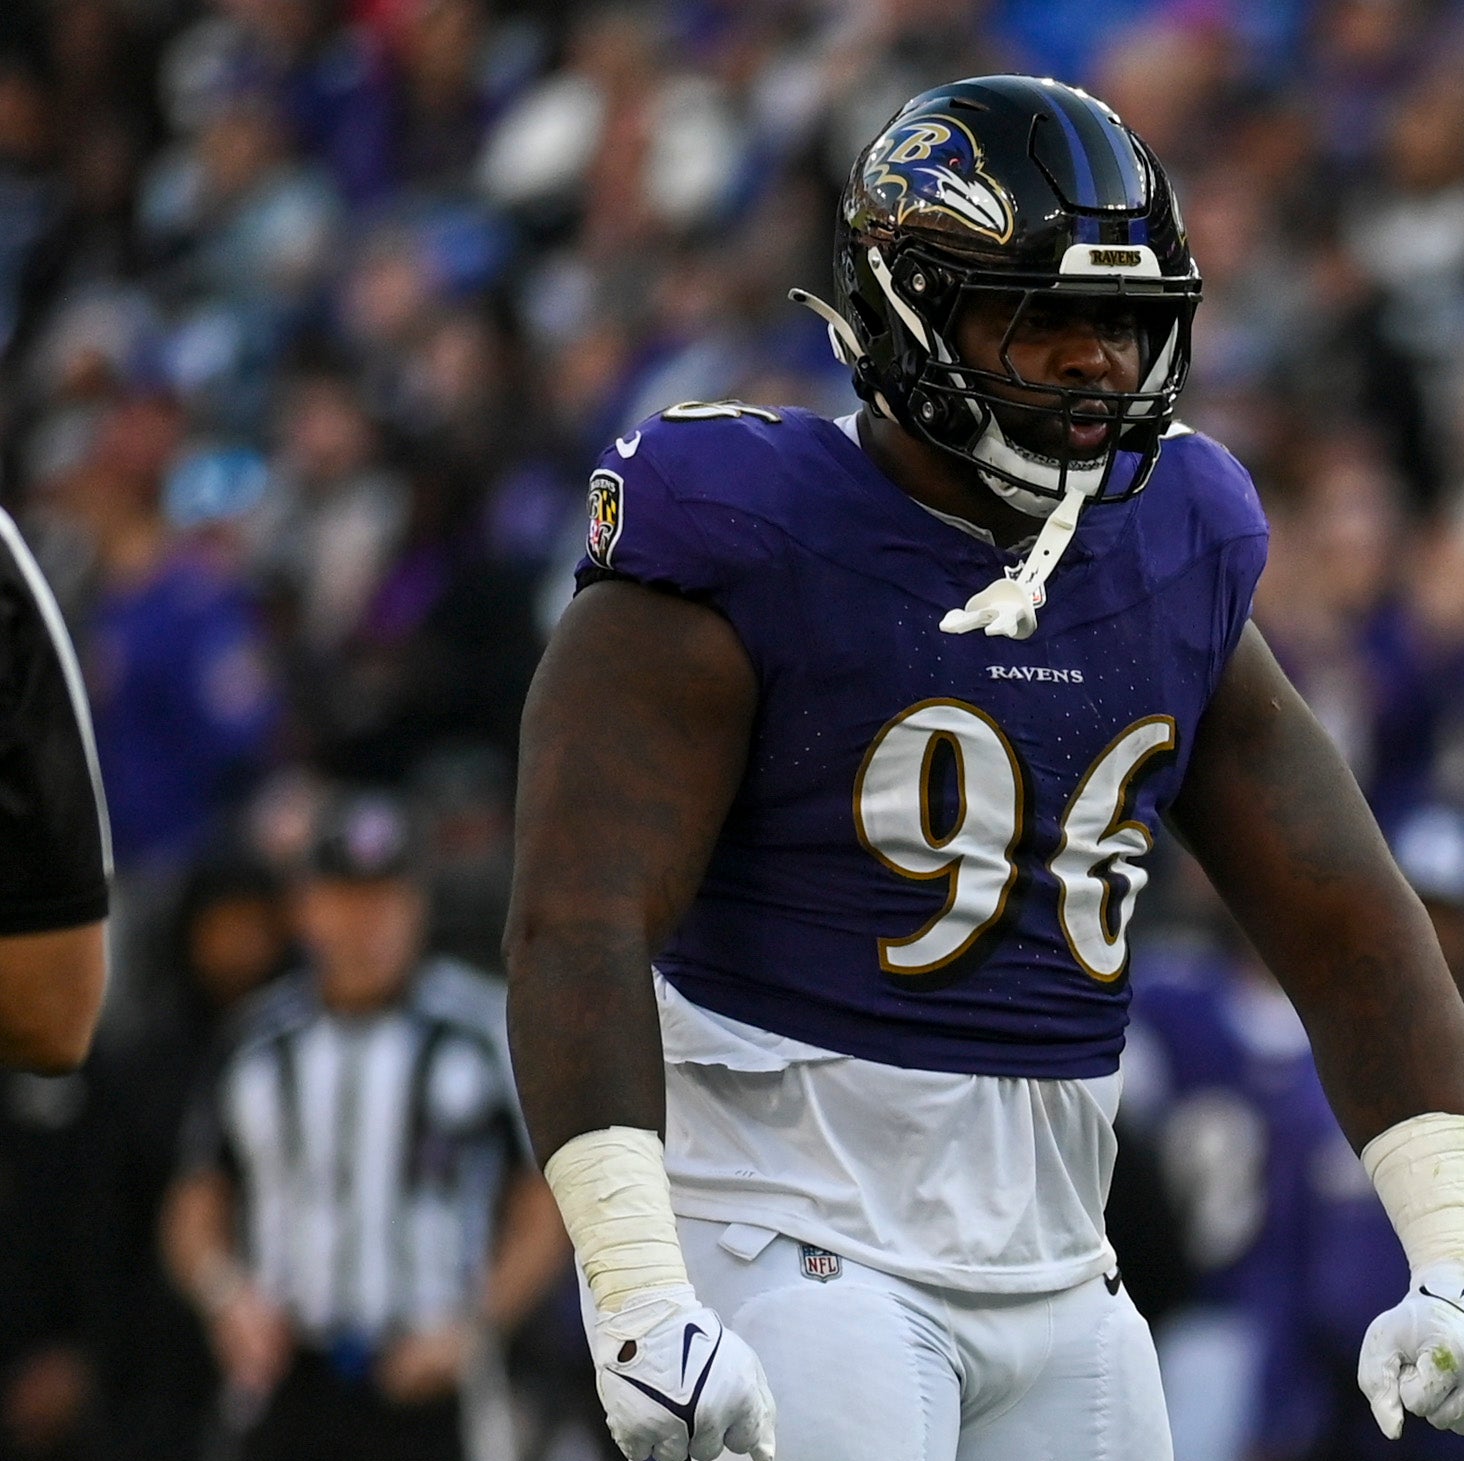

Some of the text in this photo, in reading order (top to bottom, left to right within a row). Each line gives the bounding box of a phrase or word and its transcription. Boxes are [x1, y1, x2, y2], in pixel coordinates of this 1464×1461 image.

[887, 122, 951, 164] B
[1089, 249, 1142, 267] RAVENS
[986, 665, 1084, 684] RAVENS
[853, 697, 1175, 982] 96
[807, 1257, 837, 1275] NFL
